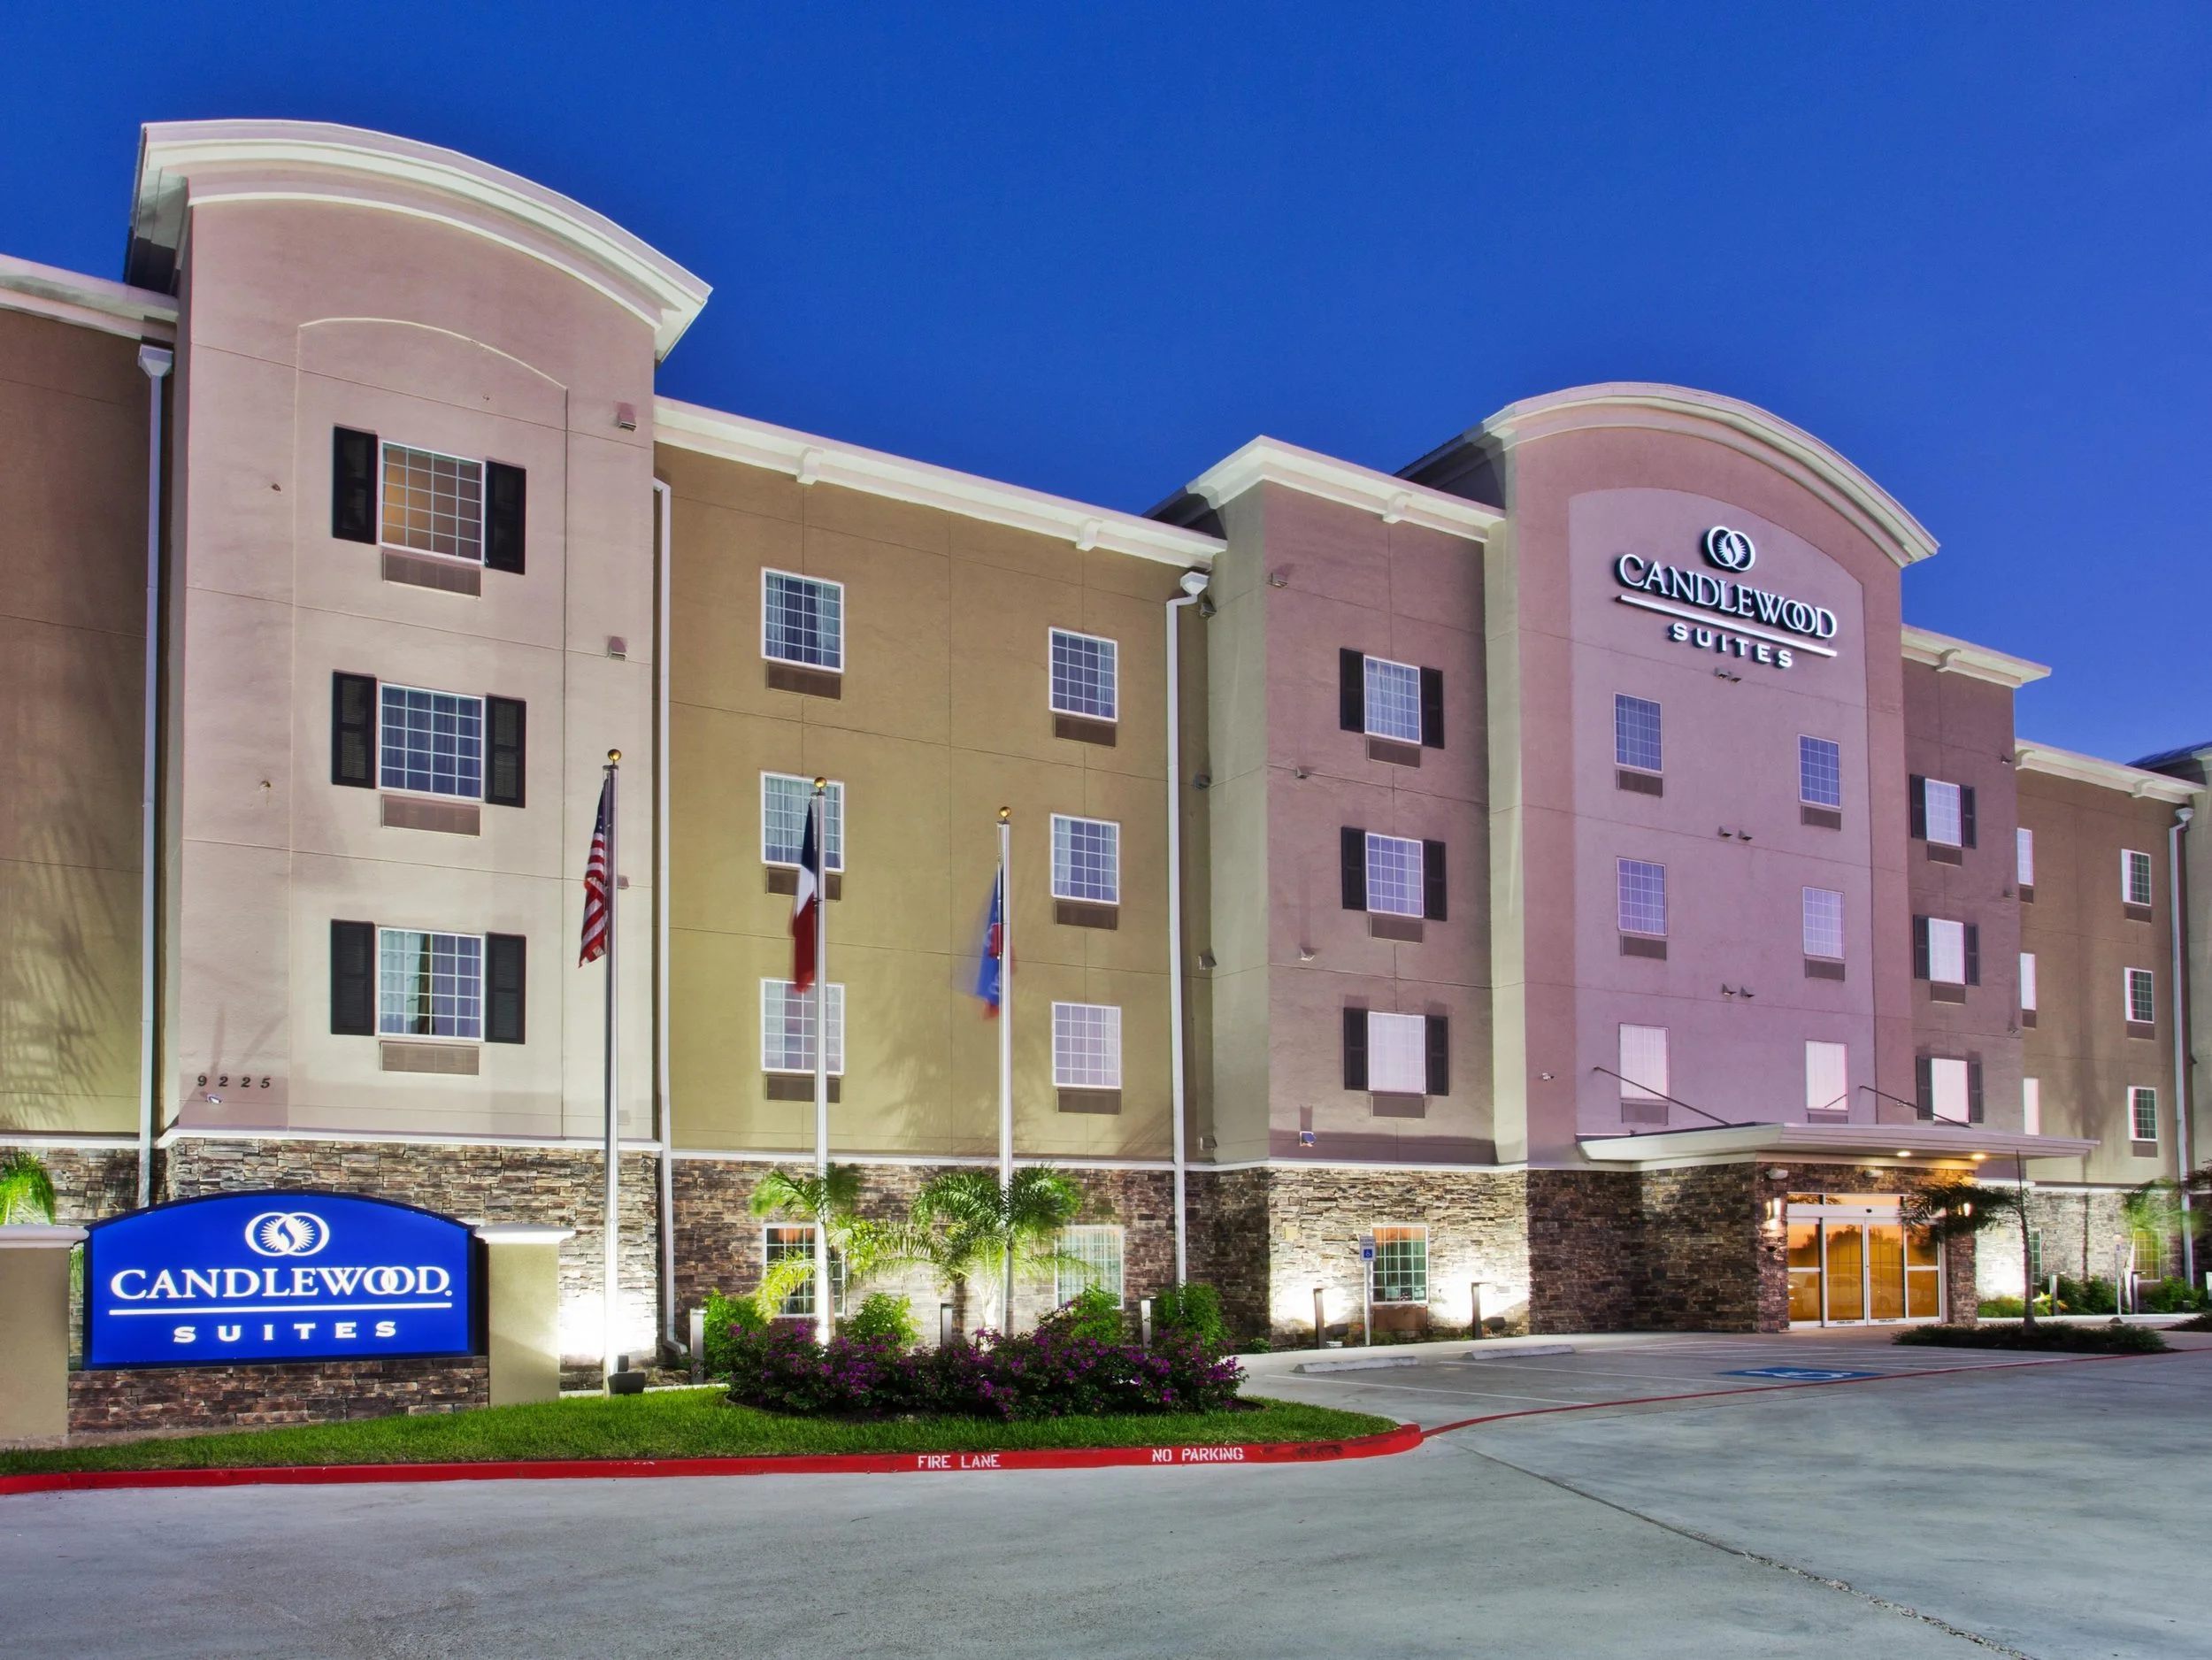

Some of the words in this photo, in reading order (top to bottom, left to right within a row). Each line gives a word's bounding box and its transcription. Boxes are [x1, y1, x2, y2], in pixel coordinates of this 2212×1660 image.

[1615, 553, 1838, 639] CANDLEWOOD
[1670, 622, 1793, 669] SUITES
[196, 1074, 271, 1089] 9225
[173, 1320, 396, 1343] SUITES
[918, 1455, 951, 1469] FIRE
[961, 1454, 1002, 1468] LANE
[1152, 1448, 1172, 1463] NO
[1181, 1447, 1244, 1462] PARKING
